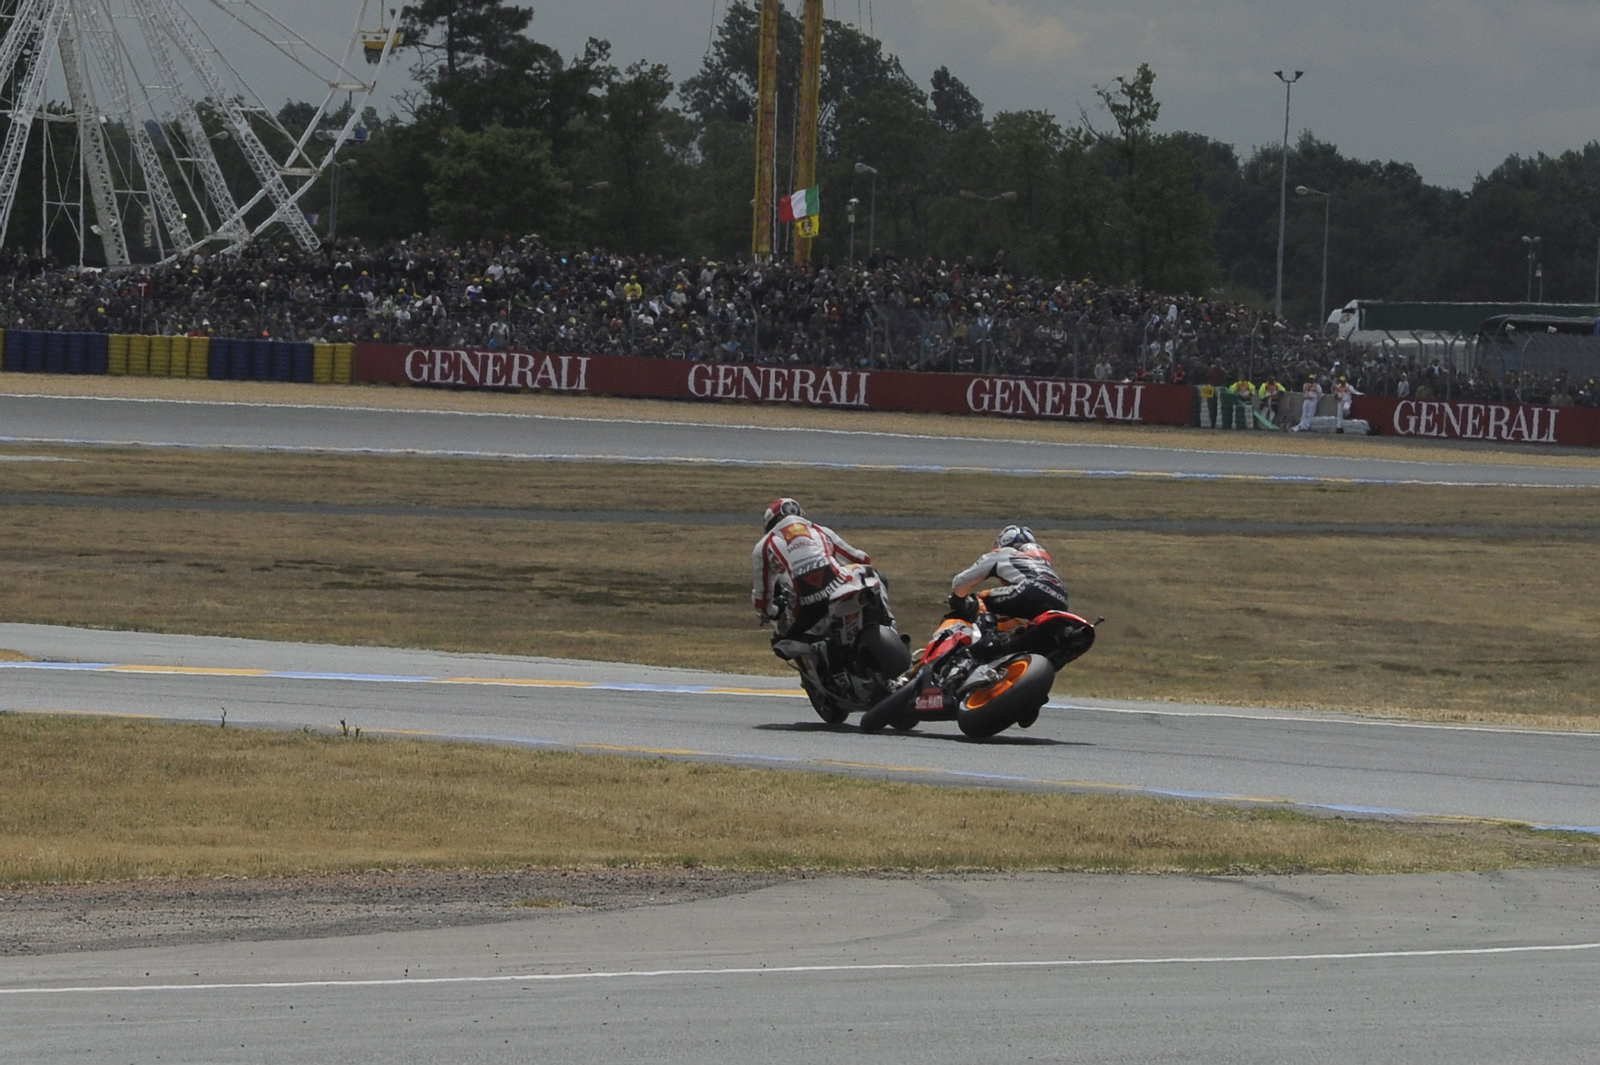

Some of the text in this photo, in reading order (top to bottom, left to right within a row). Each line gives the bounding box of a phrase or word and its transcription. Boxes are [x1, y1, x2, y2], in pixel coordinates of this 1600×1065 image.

[404, 349, 591, 390] GENERALI
[688, 363, 870, 407] GENERALI
[966, 378, 1146, 421] GENERALI
[1393, 400, 1560, 442] GENERALI
